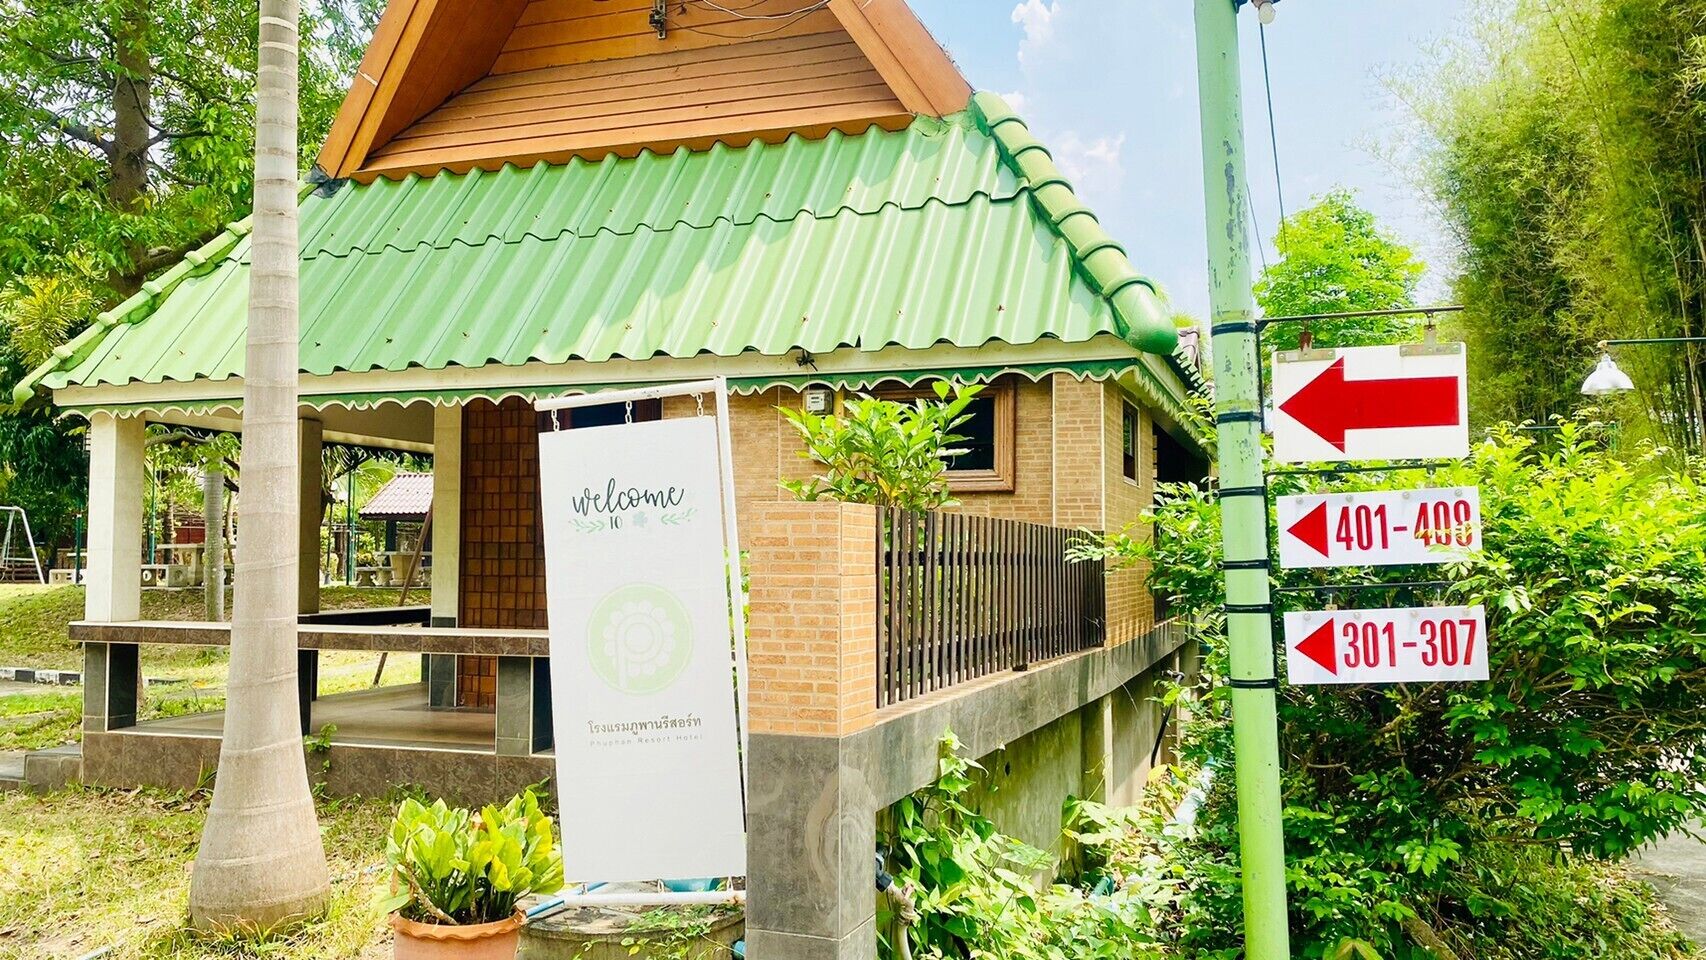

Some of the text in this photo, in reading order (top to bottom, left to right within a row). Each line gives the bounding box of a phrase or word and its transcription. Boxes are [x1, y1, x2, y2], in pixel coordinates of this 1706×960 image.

[572, 477, 685, 516] welcome
[1342, 619, 1477, 668] 301-307
[587, 712, 702, 736] โรงแรมภูพานรีสอร์ท
[637, 735, 671, 745] Resort
[676, 733, 703, 742] Hotel
